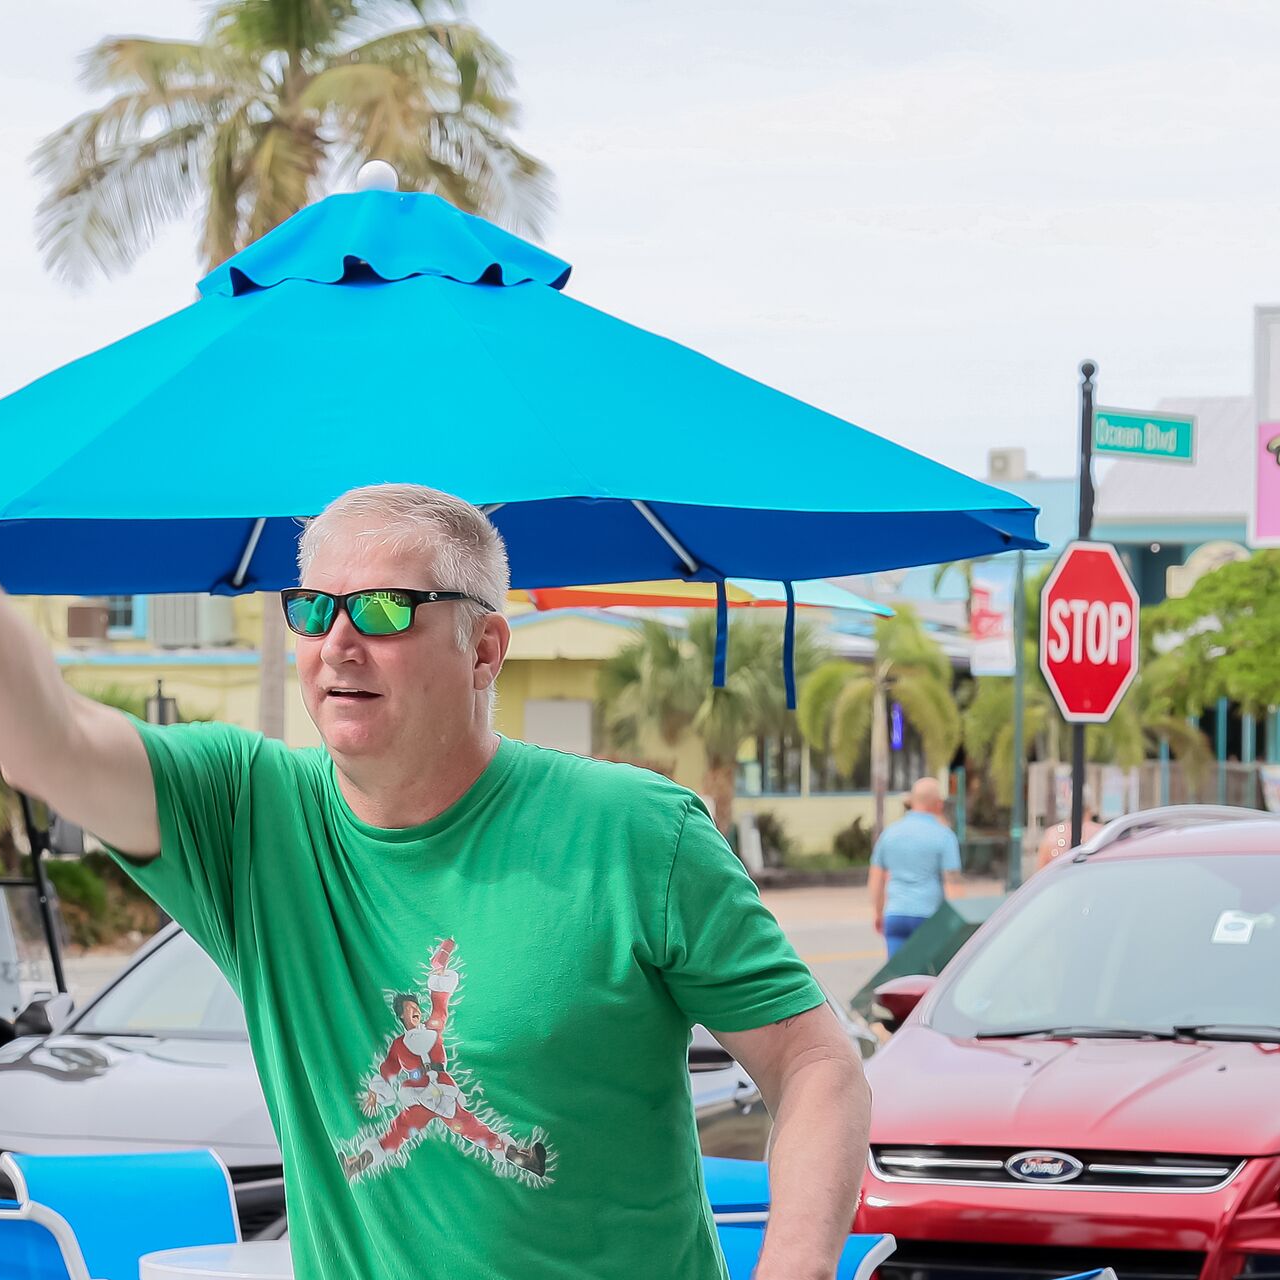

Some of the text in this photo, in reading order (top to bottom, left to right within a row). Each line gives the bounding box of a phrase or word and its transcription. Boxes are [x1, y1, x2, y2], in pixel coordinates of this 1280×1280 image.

[1095, 417, 1177, 453] Ocean Blvd
[1048, 598, 1132, 665] STOP
